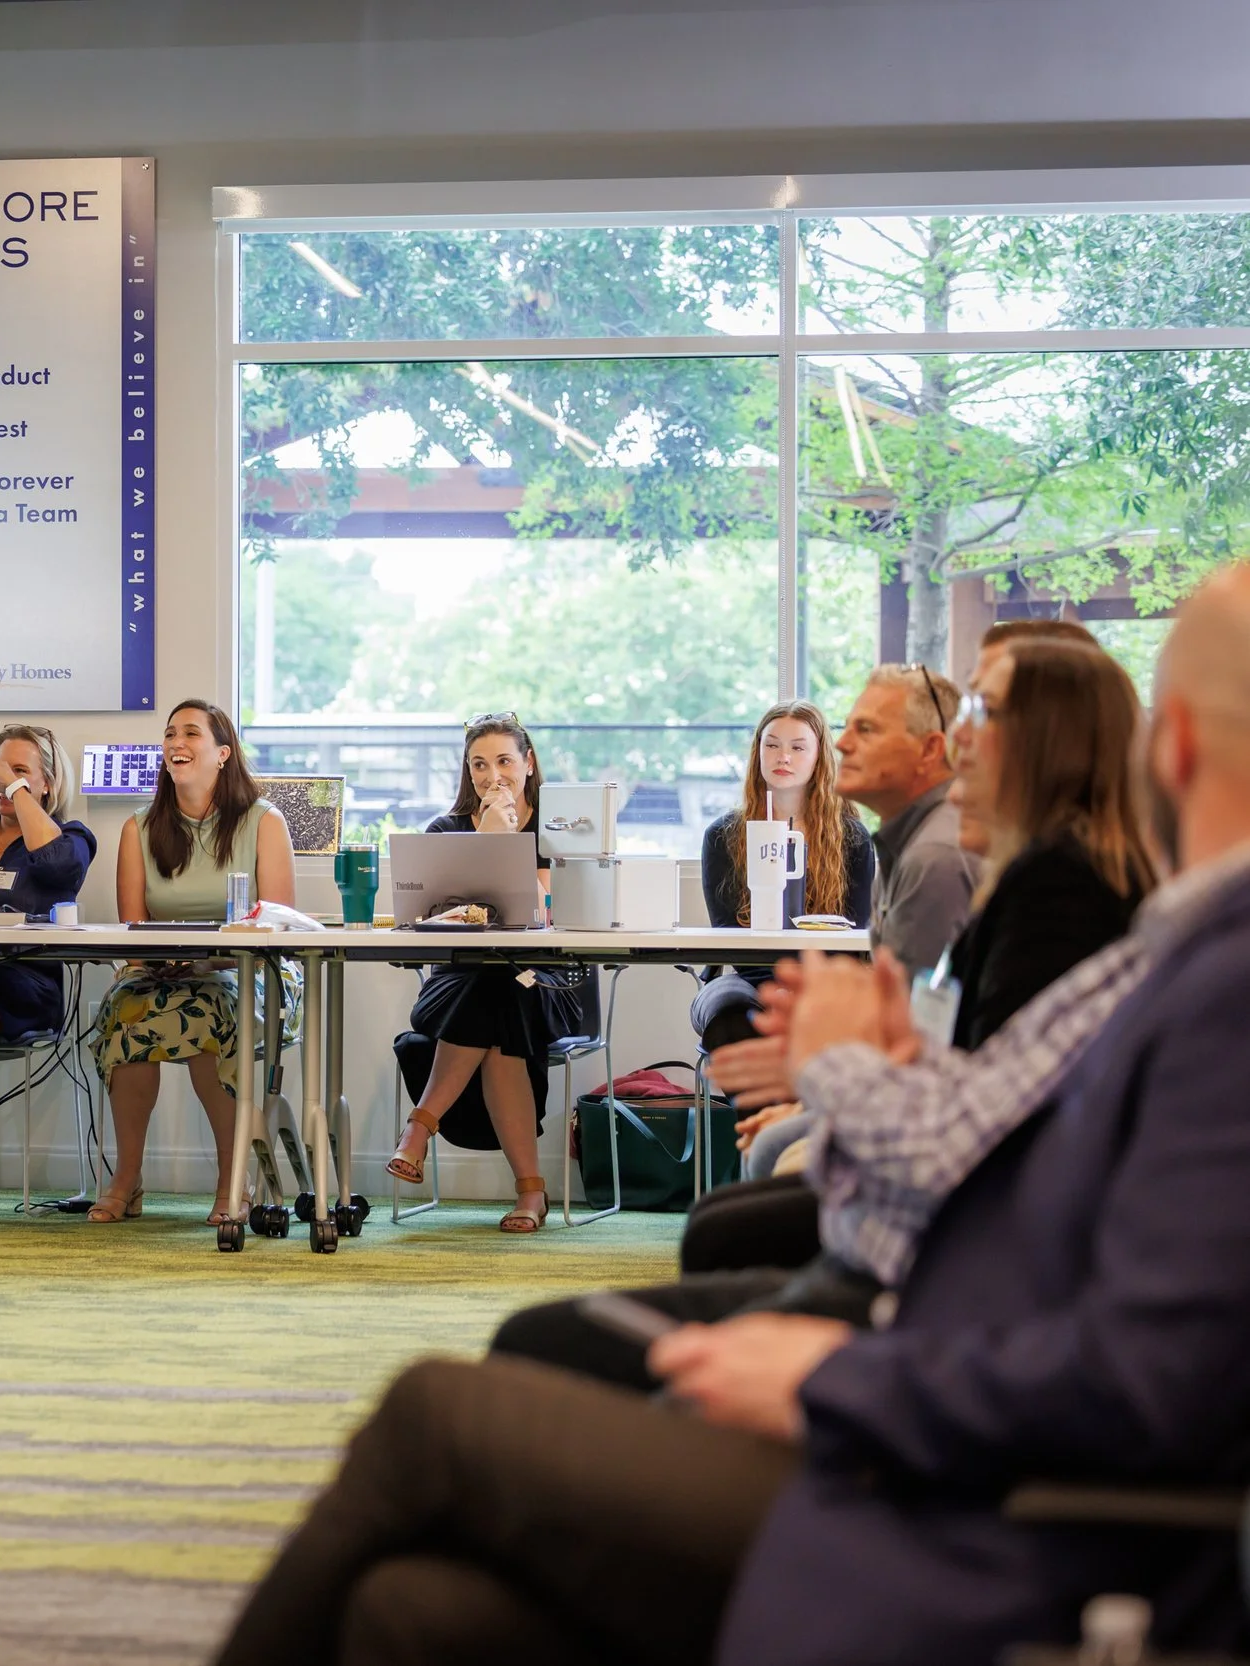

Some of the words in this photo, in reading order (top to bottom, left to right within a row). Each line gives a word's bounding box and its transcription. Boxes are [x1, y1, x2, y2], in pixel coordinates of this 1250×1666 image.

[128, 309, 145, 441] believe
[133, 466, 145, 508] we
[14, 503, 79, 524] Team
[10, 663, 73, 681] Homes
[760, 842, 785, 860] USA
